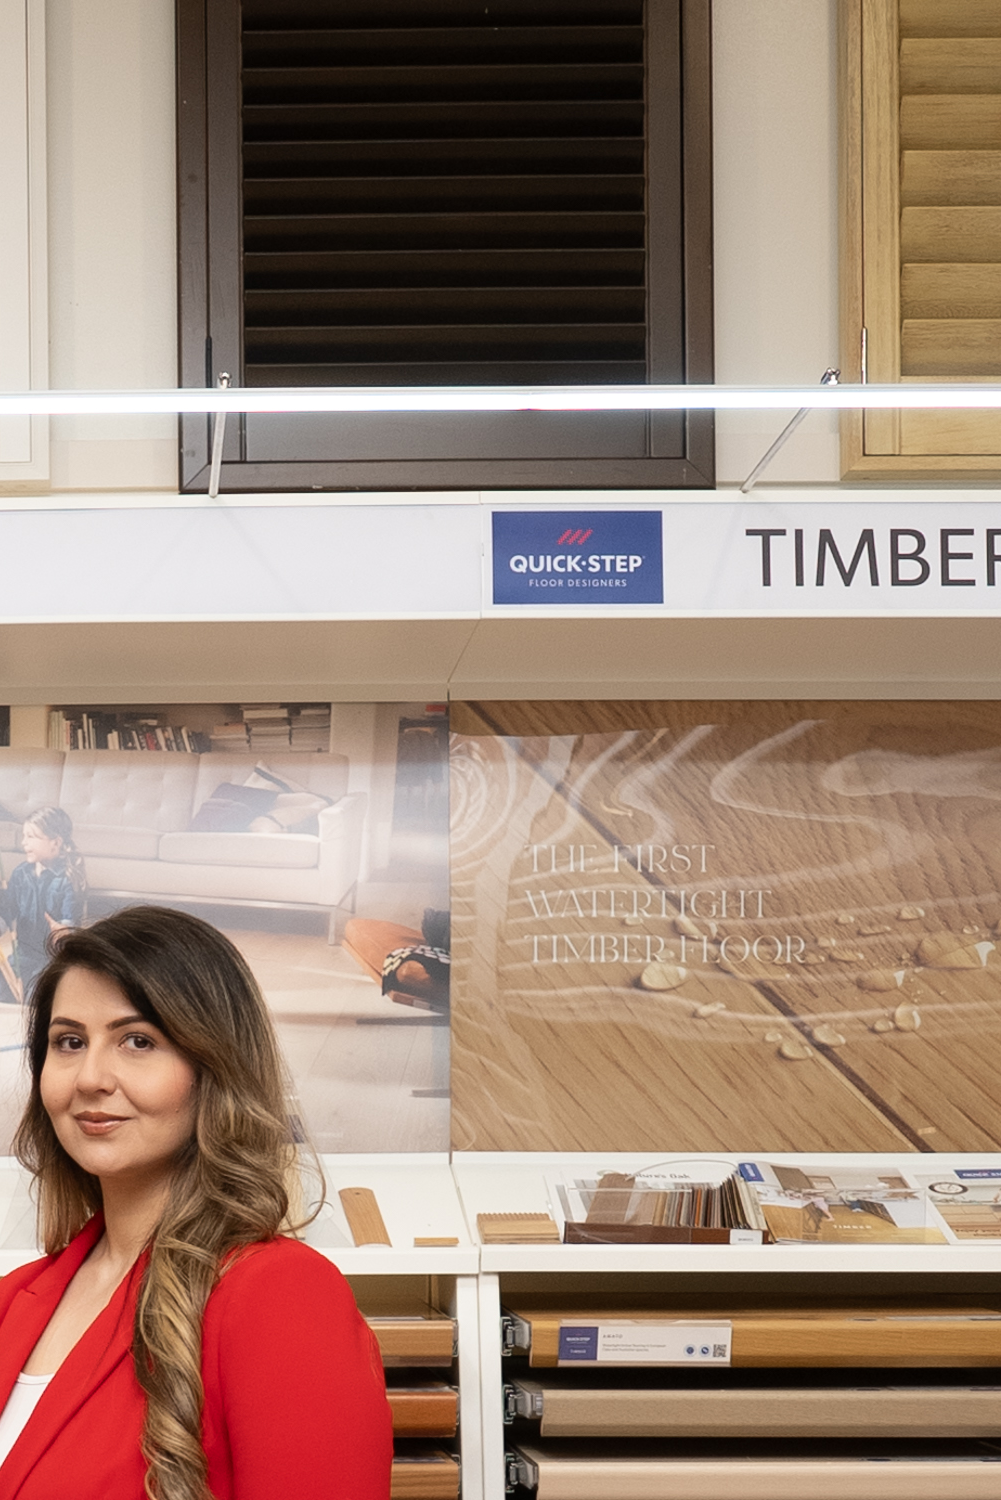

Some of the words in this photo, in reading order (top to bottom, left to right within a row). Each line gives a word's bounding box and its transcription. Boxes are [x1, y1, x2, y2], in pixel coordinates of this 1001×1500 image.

[528, 578, 564, 588] FLOOR
[567, 578, 628, 588] DESIGNERS
[524, 843, 597, 873] THE
[612, 843, 716, 873] FIRST
[525, 889, 773, 919] WATERTIGHT
[524, 934, 666, 964] TIMBER
[680, 934, 807, 964] FLOOR
